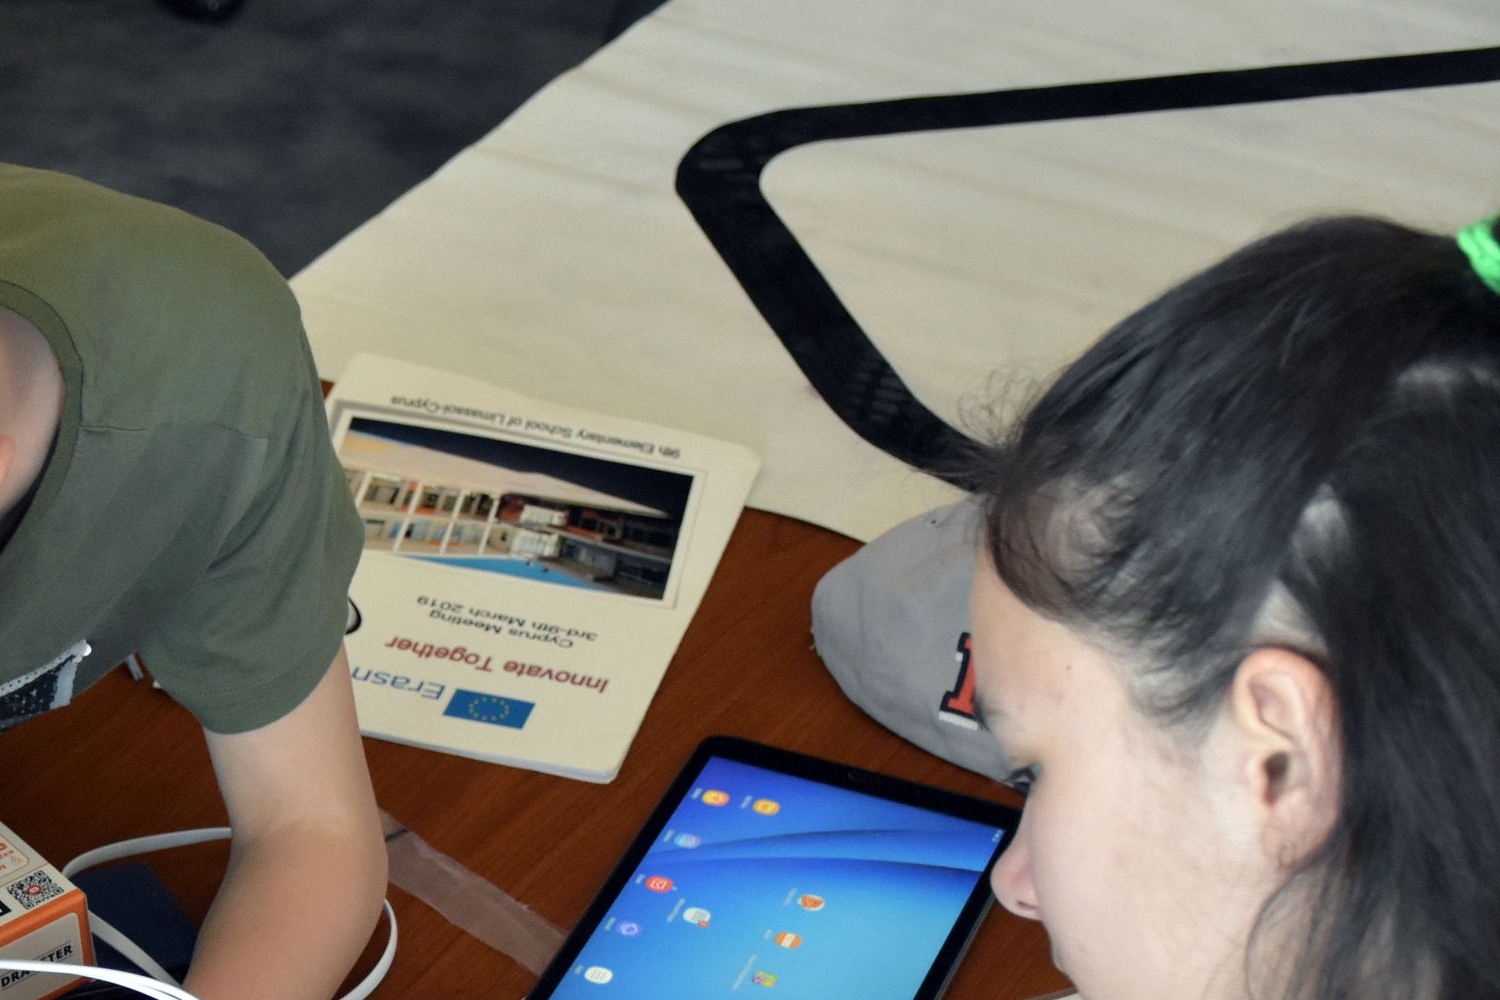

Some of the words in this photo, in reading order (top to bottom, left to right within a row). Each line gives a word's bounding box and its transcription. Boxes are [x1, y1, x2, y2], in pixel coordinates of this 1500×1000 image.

[508, 414, 523, 428] of
[525, 419, 573, 440] School
[577, 426, 655, 455] Elementary
[417, 595, 464, 613] 2019
[429, 609, 502, 635] Meeting
[469, 606, 526, 629] March
[508, 628, 575, 649] Cyprus
[532, 619, 598, 641] 3rd-9th
[385, 635, 493, 672] Together
[503, 660, 610, 694] Innovate
[0, 943, 72, 987] DRATER
